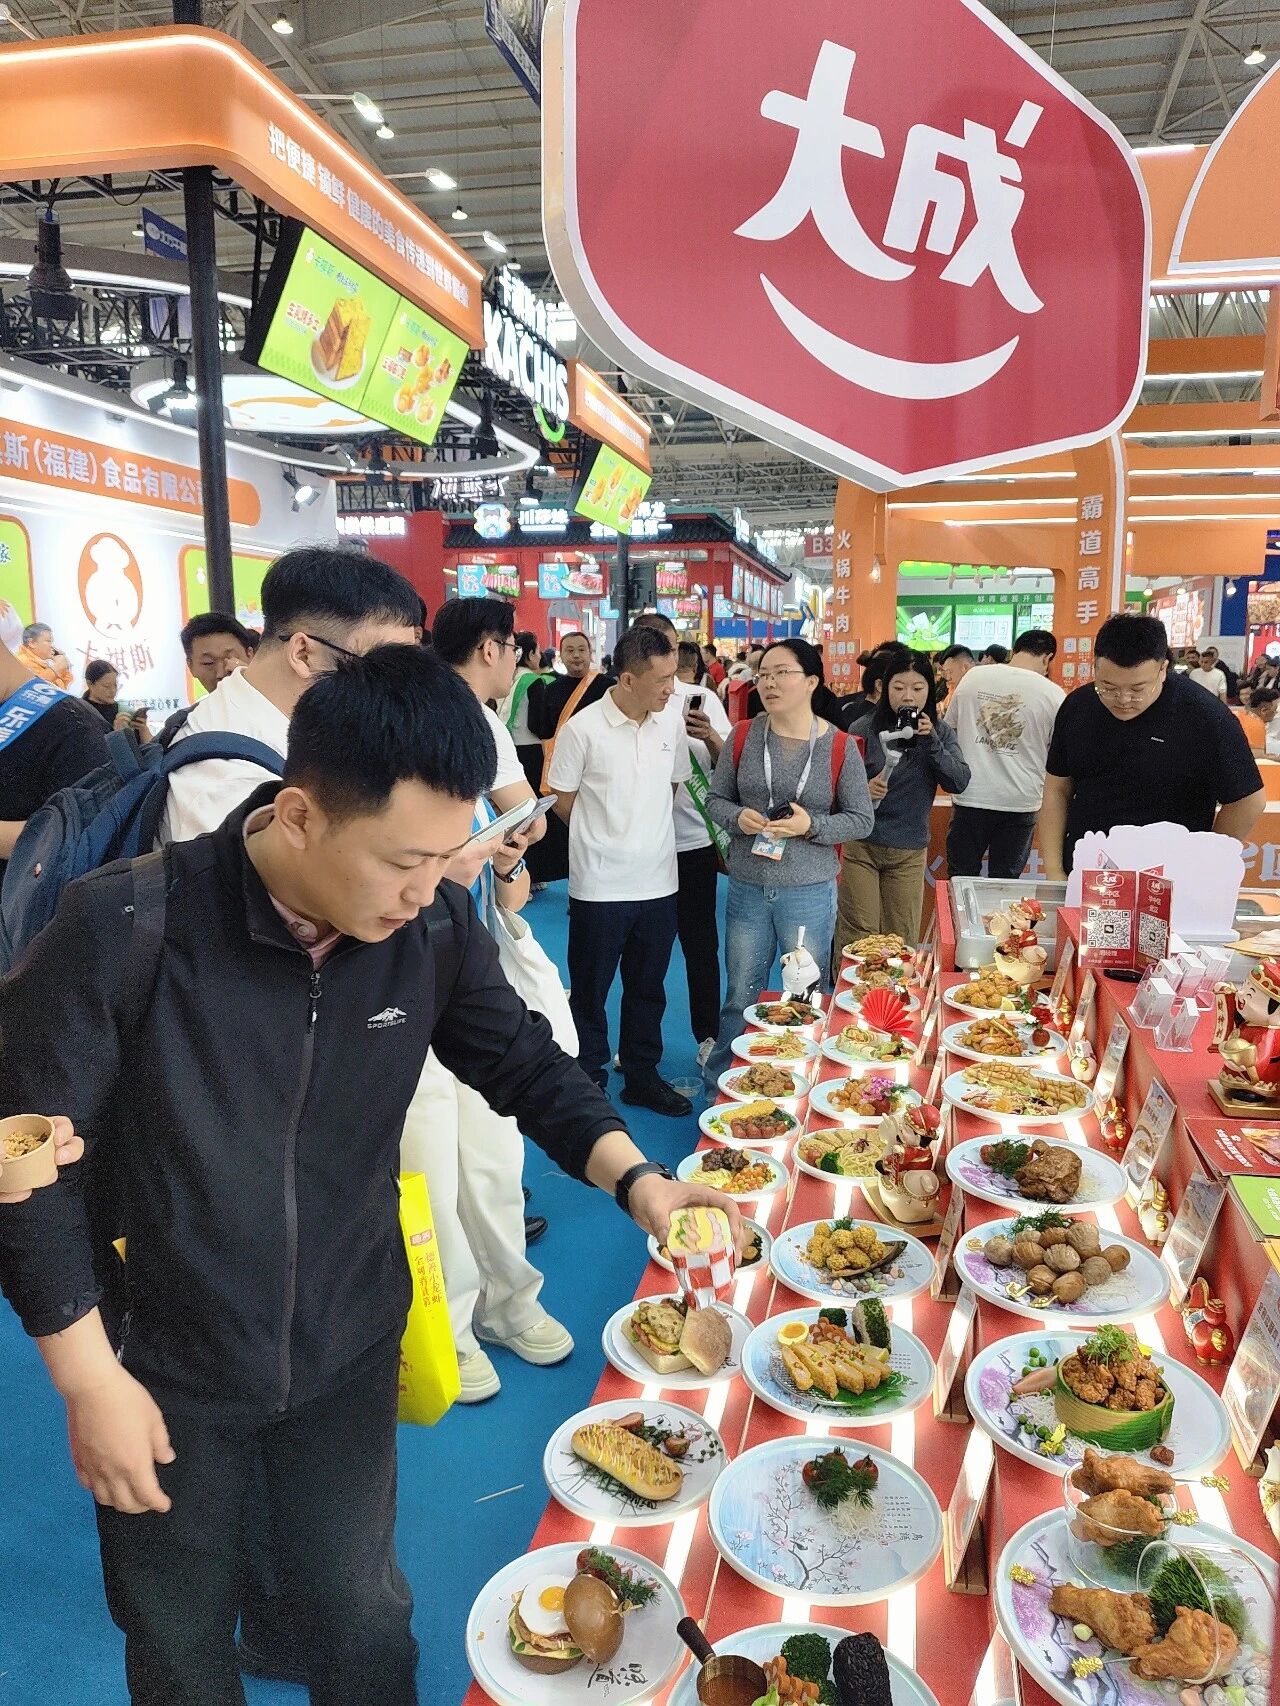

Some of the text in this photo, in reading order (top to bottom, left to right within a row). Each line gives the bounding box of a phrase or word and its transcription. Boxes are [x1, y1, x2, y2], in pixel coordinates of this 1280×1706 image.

[733, 39, 1045, 314] 大成
[484, 301, 570, 422] KACHIS
[0, 431, 203, 505] 斯(福建)食品有限公
[835, 529, 852, 633] 火锅牛肉
[1076, 494, 1104, 625] 霸道高手
